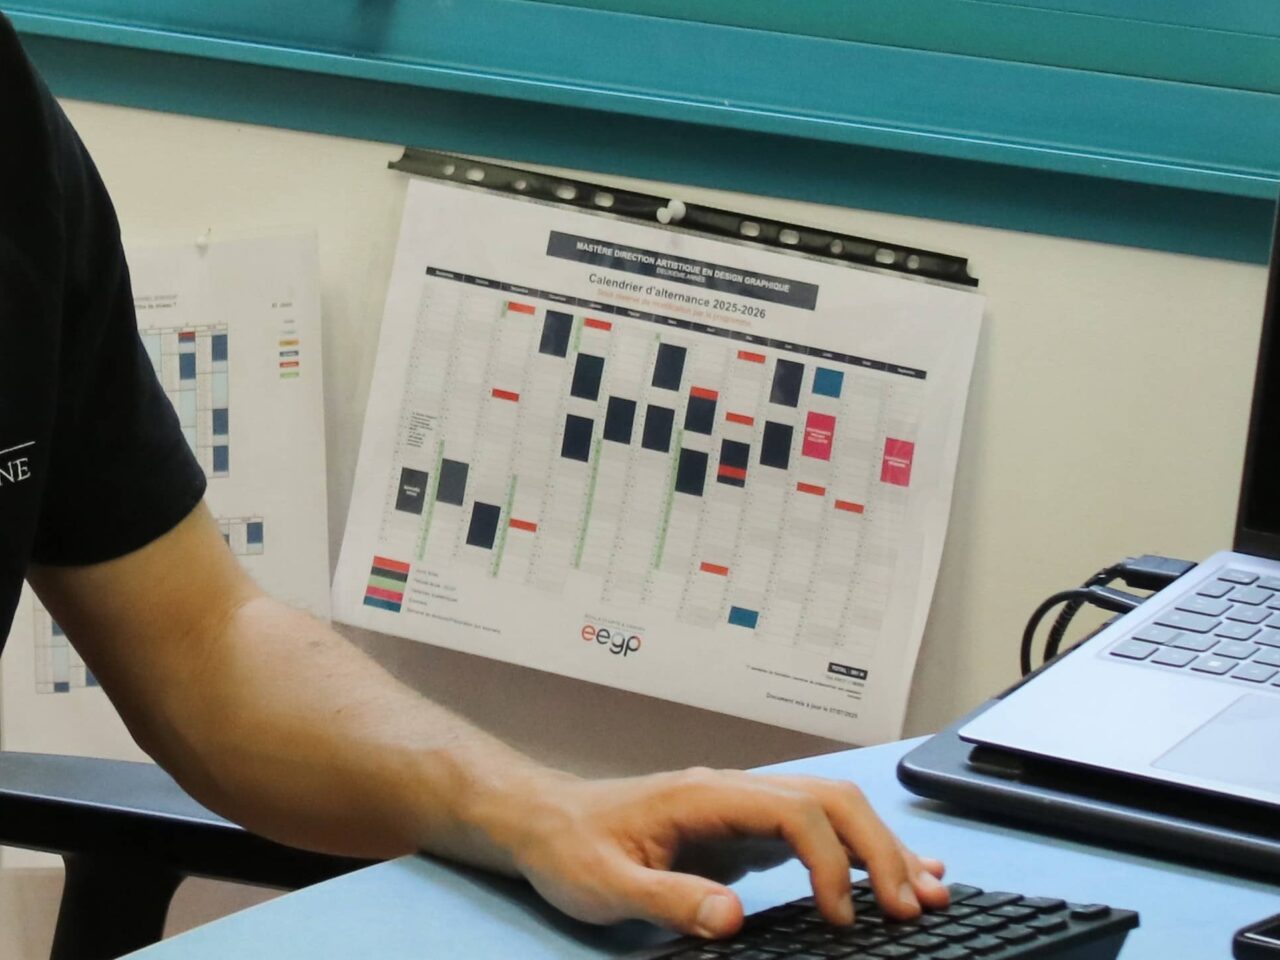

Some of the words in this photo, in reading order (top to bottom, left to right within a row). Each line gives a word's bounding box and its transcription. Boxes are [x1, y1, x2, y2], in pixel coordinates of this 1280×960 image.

[614, 249, 656, 265] DIRECTION
[655, 258, 701, 274] ARTISTIQUE
[701, 267, 714, 277] EN
[744, 276, 791, 293] GRAPHIQUE
[588, 273, 644, 293] Calendrier
[645, 284, 710, 308] d'alternance
[712, 298, 767, 319] 2025-2026
